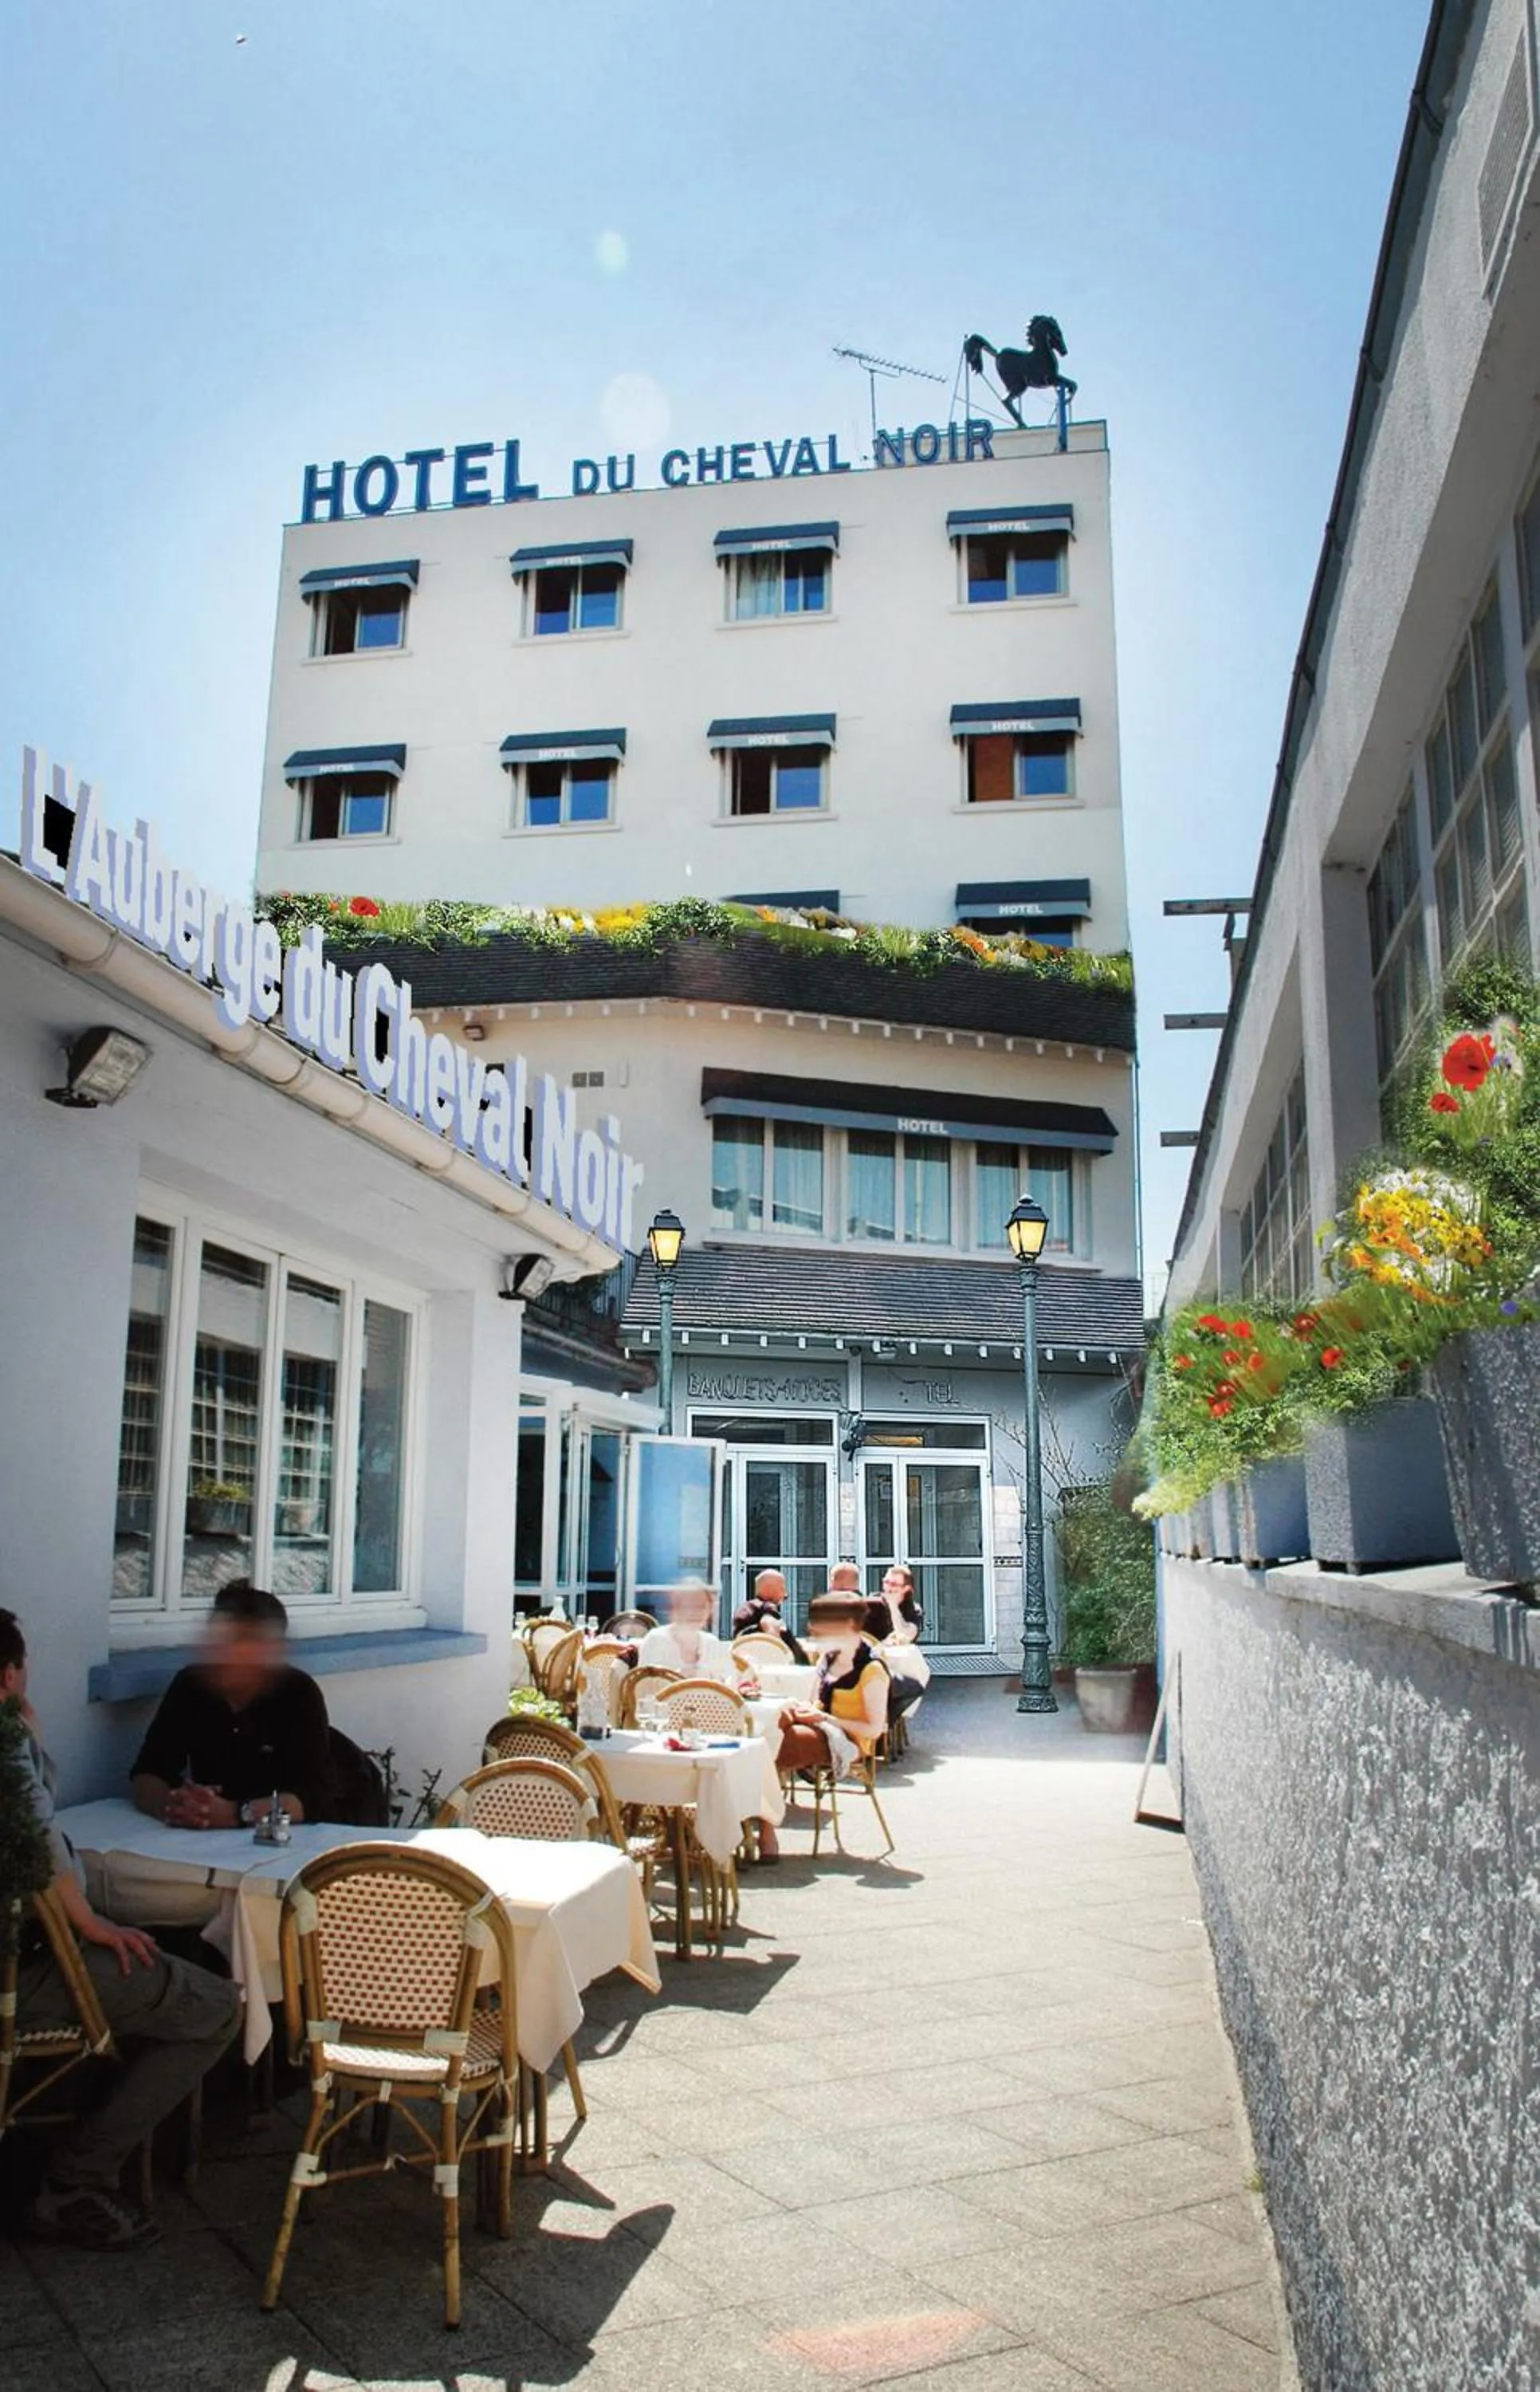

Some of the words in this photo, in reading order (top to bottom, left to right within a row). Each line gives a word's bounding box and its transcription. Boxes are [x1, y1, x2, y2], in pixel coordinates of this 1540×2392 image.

[301, 439, 540, 523] HOTEL
[572, 454, 635, 496] DU
[661, 434, 851, 486] CHEVAL
[875, 418, 996, 467] NOIR
[988, 522, 1031, 531] HOTEL
[992, 721, 1035, 731] HOTEL
[748, 735, 790, 746] HOTEL
[999, 904, 1043, 915] HOTEL
[21, 744, 281, 1032] L'Auberge
[283, 924, 355, 1072] du
[353, 962, 531, 1182] Cheval
[532, 1073, 644, 1253] Noir
[898, 1118, 949, 1134] HOTEL
